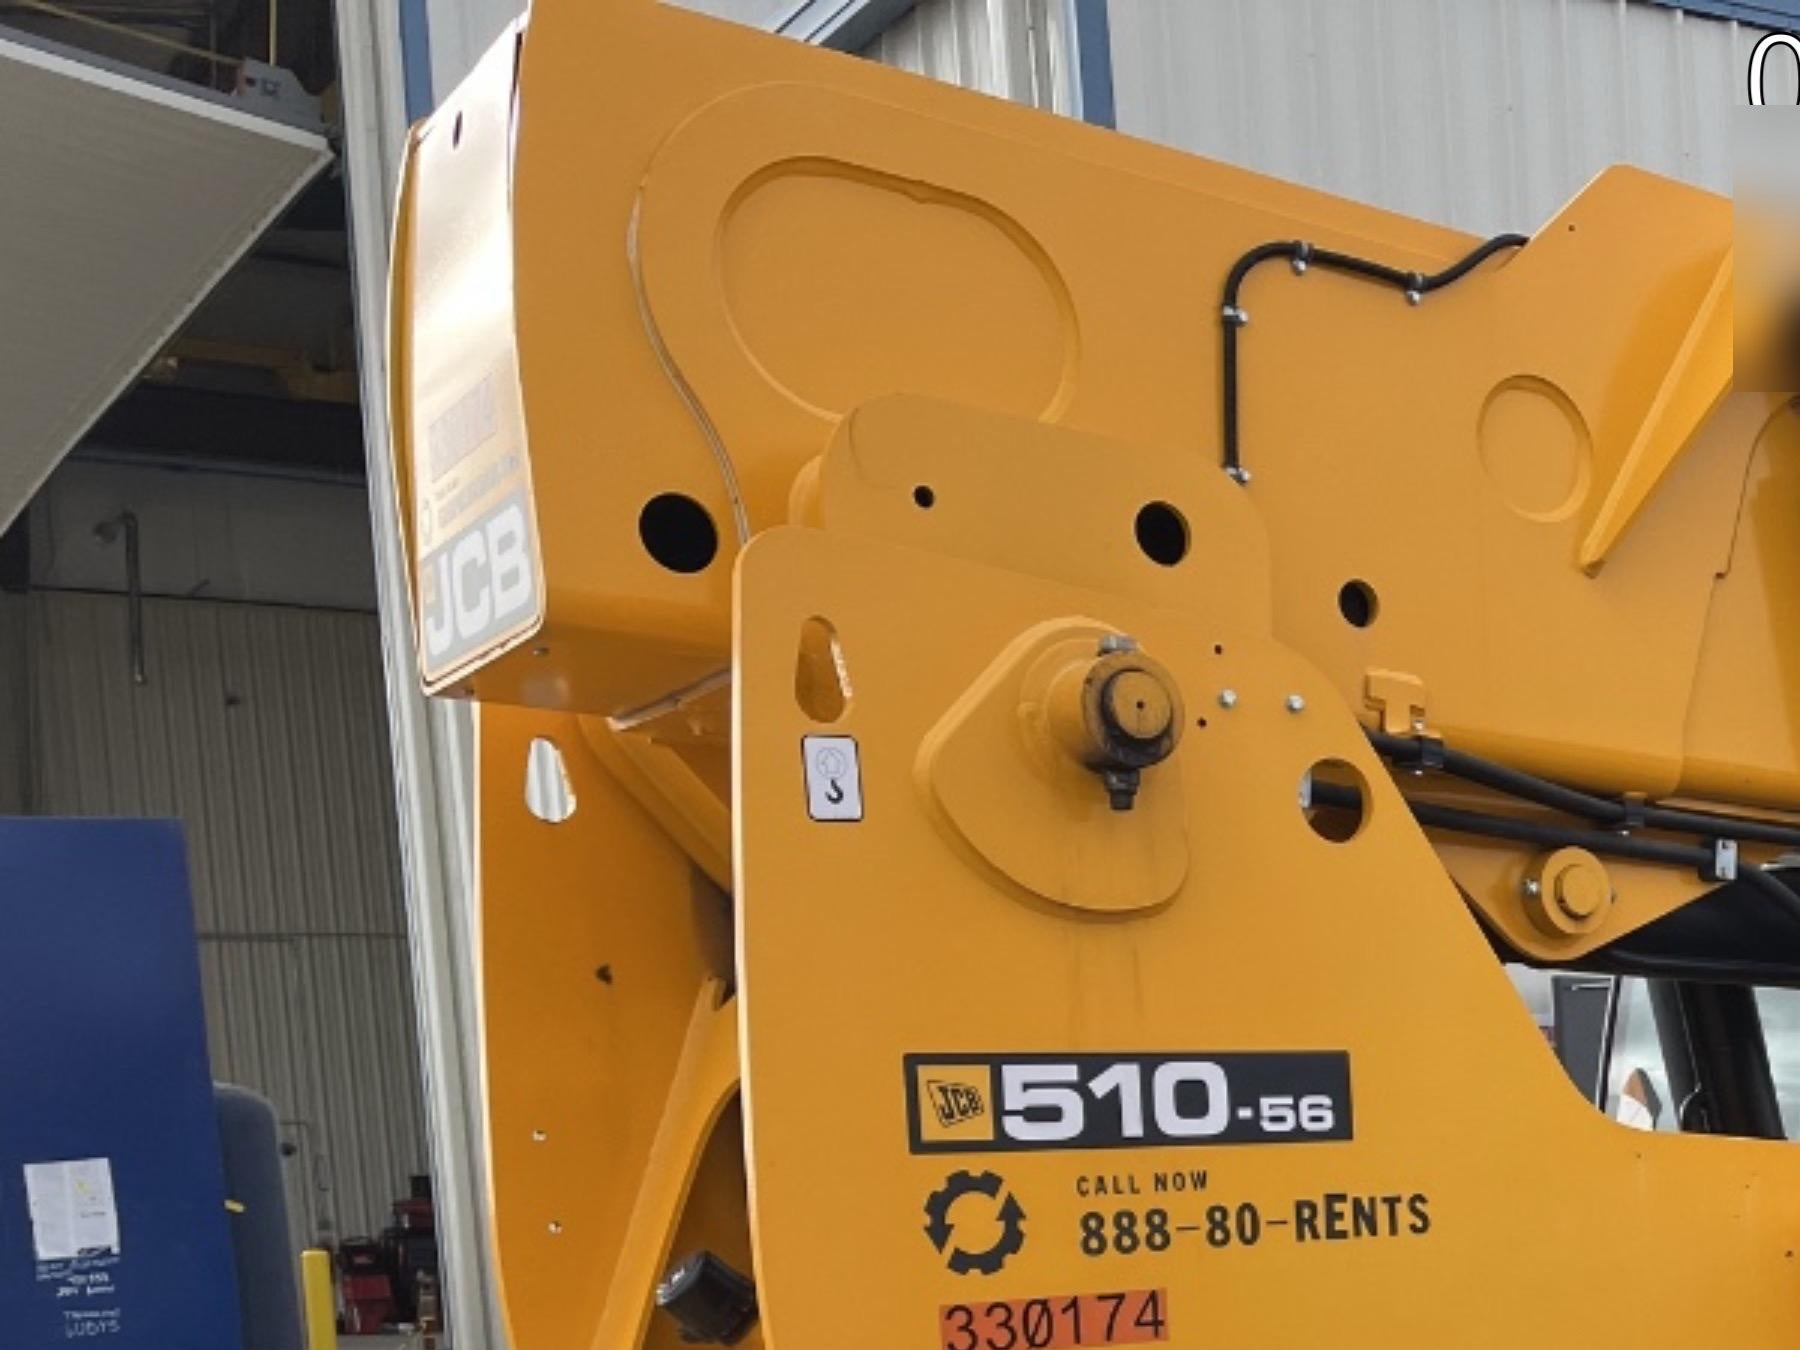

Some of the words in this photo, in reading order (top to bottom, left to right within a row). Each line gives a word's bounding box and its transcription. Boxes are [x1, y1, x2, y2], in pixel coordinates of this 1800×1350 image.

[426, 504, 532, 655] JCB
[1076, 1174, 1141, 1196] CALL
[1154, 1170, 1208, 1192] NOW
